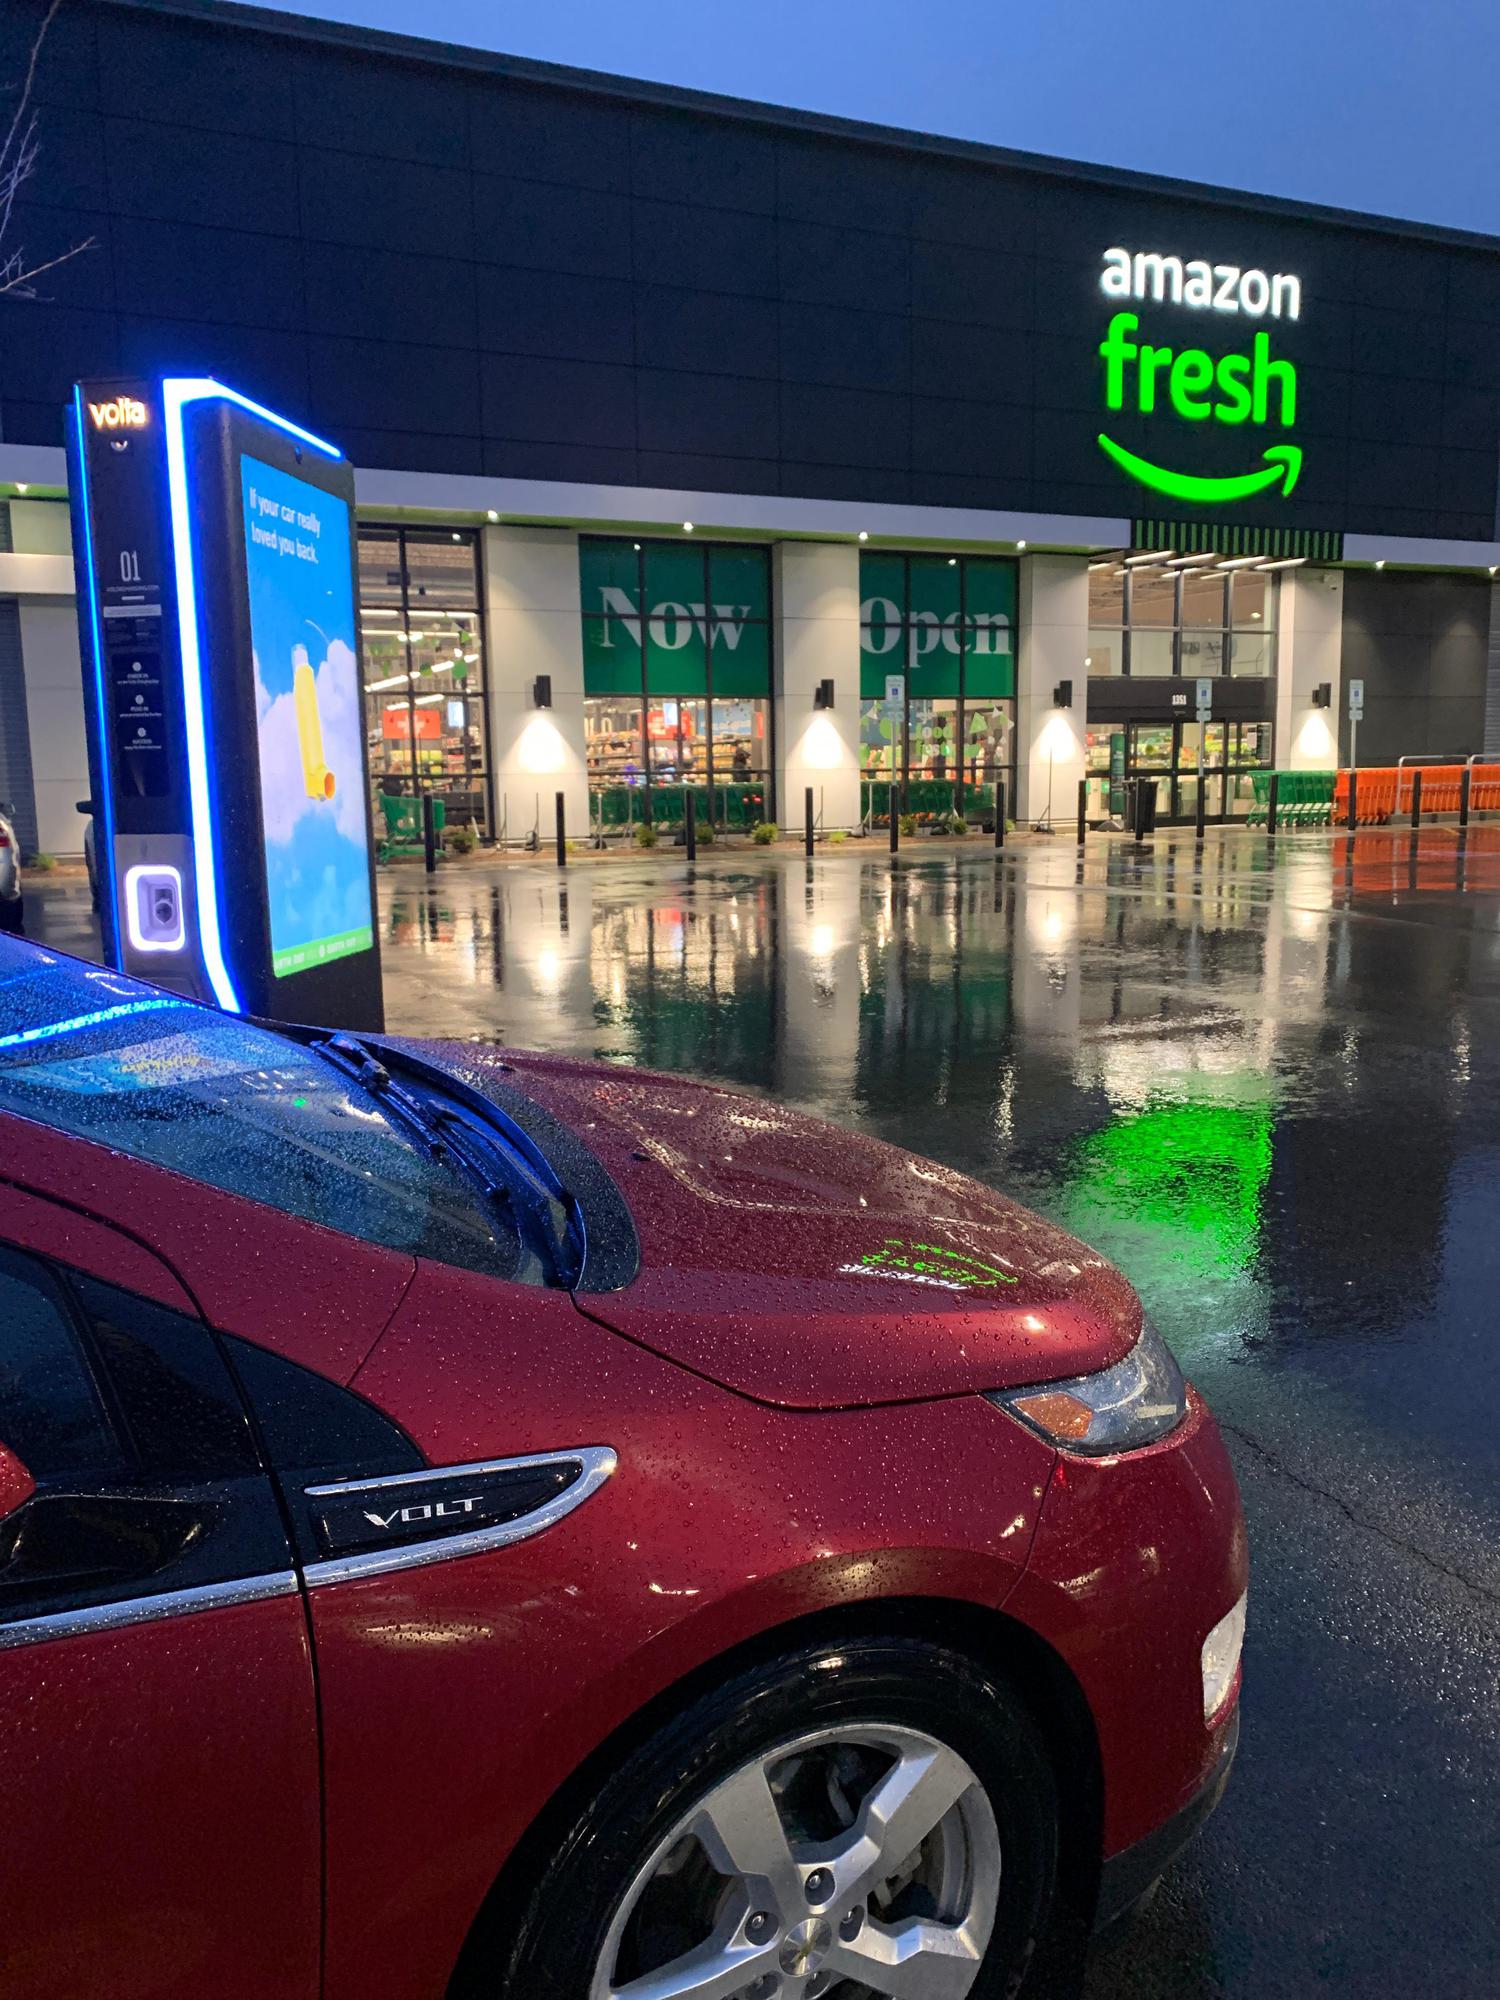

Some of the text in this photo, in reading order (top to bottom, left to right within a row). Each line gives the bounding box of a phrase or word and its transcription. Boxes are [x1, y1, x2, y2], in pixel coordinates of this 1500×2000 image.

[1101, 247, 1301, 321] amazon
[1099, 312, 1297, 427] fresh
[249, 487, 321, 539] If your car really
[251, 520, 278, 550] loved
[278, 535, 295, 557] you
[120, 550, 141, 582] 01
[598, 585, 1013, 669] Now Open
[363, 1496, 483, 1528] VOLT
